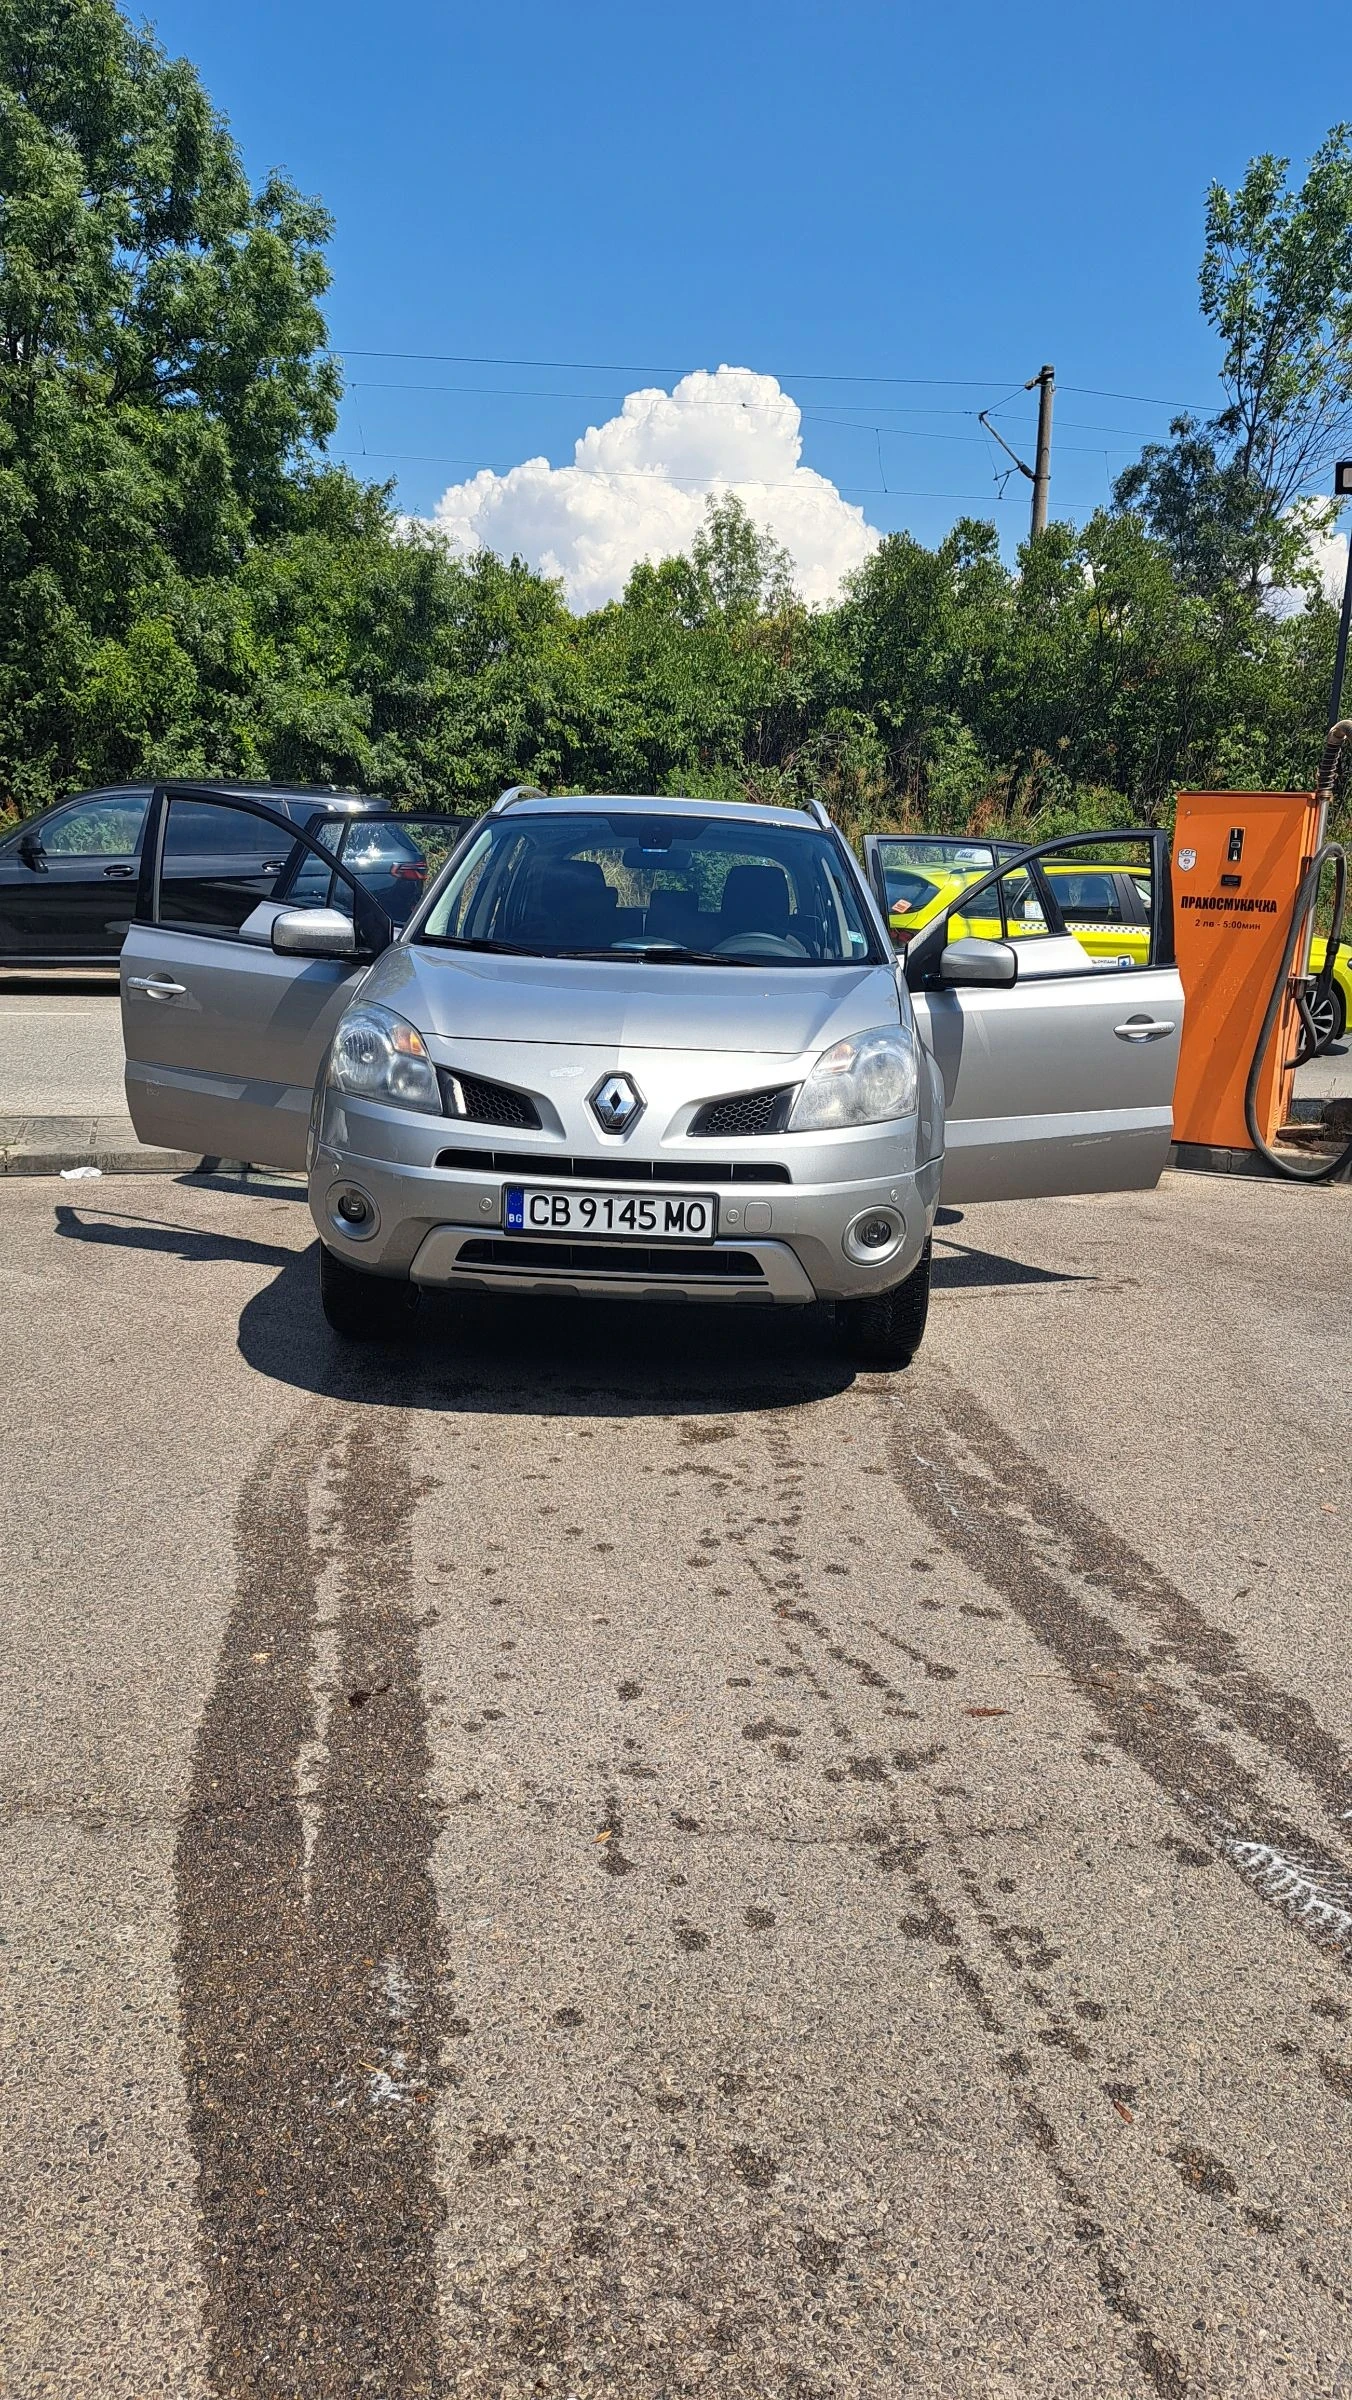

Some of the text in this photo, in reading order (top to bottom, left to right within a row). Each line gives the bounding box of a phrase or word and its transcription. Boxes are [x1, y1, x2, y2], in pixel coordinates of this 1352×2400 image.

[1195, 919, 1200, 927] 2
[1203, 920, 1214, 928] лв
[1223, 920, 1261, 930] 5:00мин
[508, 1213, 522, 1223] BG
[529, 1195, 707, 1232] CB 9145 MO
